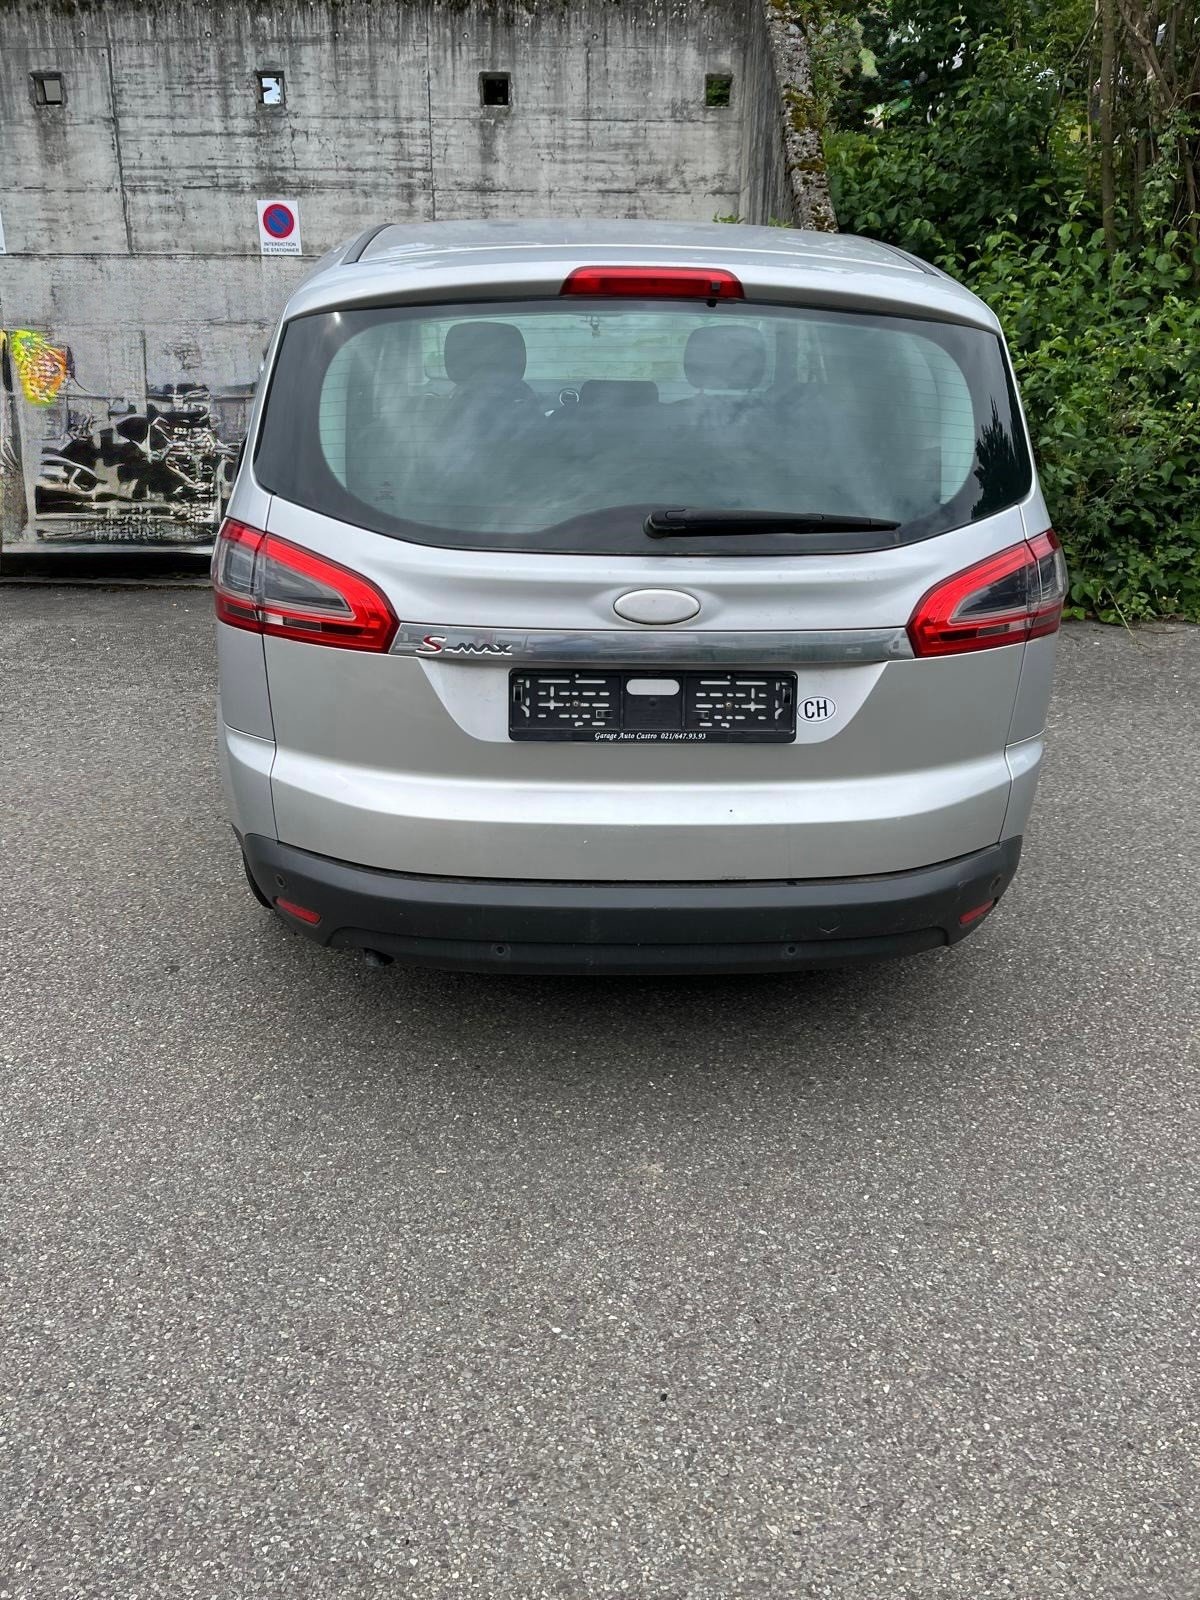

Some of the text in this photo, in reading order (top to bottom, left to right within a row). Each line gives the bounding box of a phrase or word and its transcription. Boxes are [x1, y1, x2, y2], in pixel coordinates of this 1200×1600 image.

[804, 700, 828, 719] CH
[594, 732, 706, 741] Garage Auto Castro 021/647.93.93
